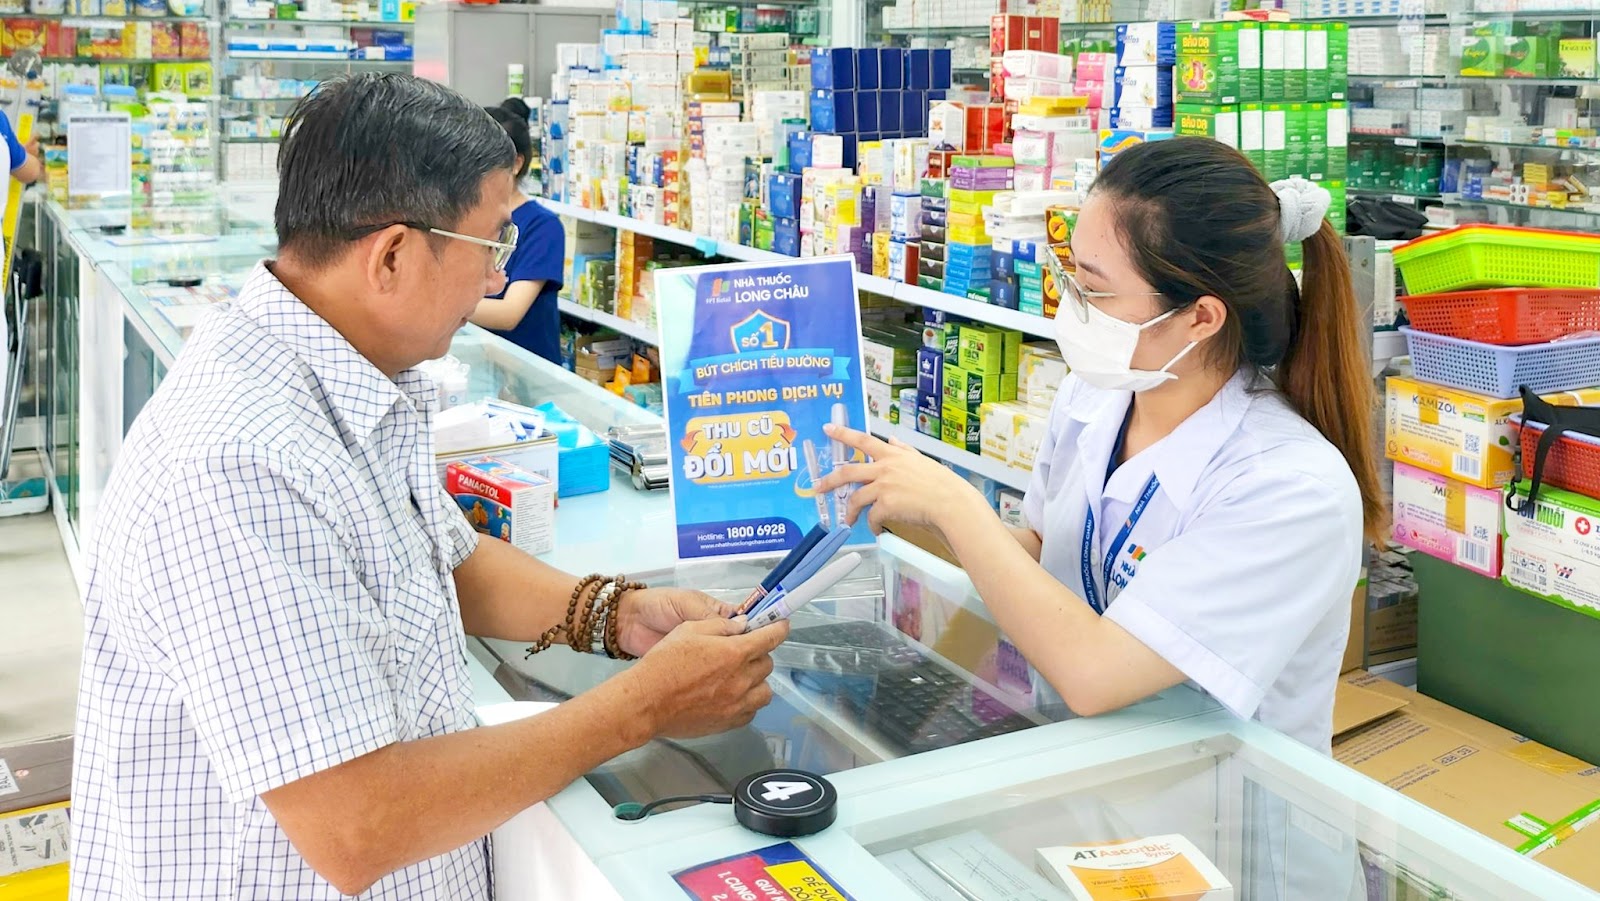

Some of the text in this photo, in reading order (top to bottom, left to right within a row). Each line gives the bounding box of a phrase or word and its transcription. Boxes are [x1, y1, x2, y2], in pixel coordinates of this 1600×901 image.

[733, 272, 792, 288] NHÀ THUỐC
[735, 284, 809, 304] LONG CHÂU
[759, 320, 779, 348] 1
[695, 353, 831, 379] BÚT CHÍCH TIỂU ĐƯỜNG
[688, 382, 844, 408] TIÊN PHONG DỊCH VỤ
[1412, 395, 1457, 415] KAMIZOL
[701, 414, 774, 440] THU CŨ
[683, 441, 798, 478] ĐỔI MỚI
[457, 474, 500, 501] PANACTOL
[697, 523, 787, 541] Hotline: 1800 6928
[1085, 518, 1094, 541] CHÂU
[1082, 540, 1090, 563] LONG
[1083, 565, 1093, 589] THUỐC
[1111, 569, 1129, 589] LON
[760, 781, 813, 801] 4
[1099, 842, 1171, 858] Ascorbic
